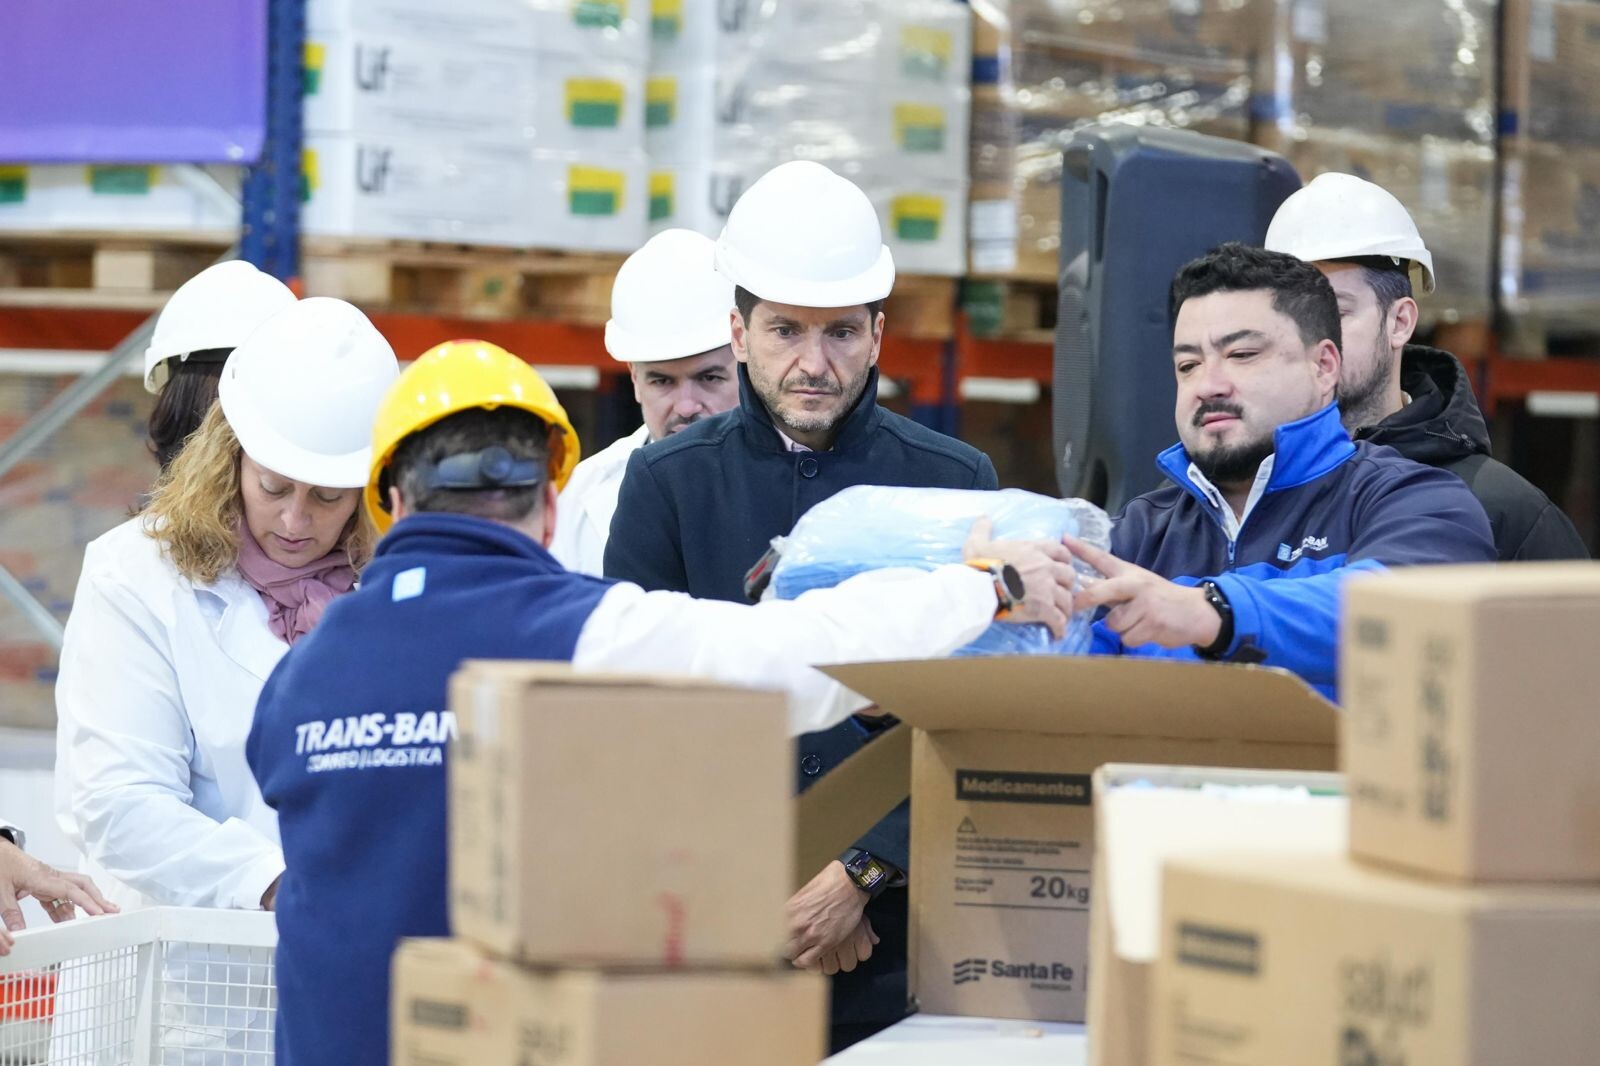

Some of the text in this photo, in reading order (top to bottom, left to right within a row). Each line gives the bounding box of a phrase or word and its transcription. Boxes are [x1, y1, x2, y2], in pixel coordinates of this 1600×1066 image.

[961, 777, 1085, 797] Medicamentos
[991, 960, 1073, 981] Santa Fe
